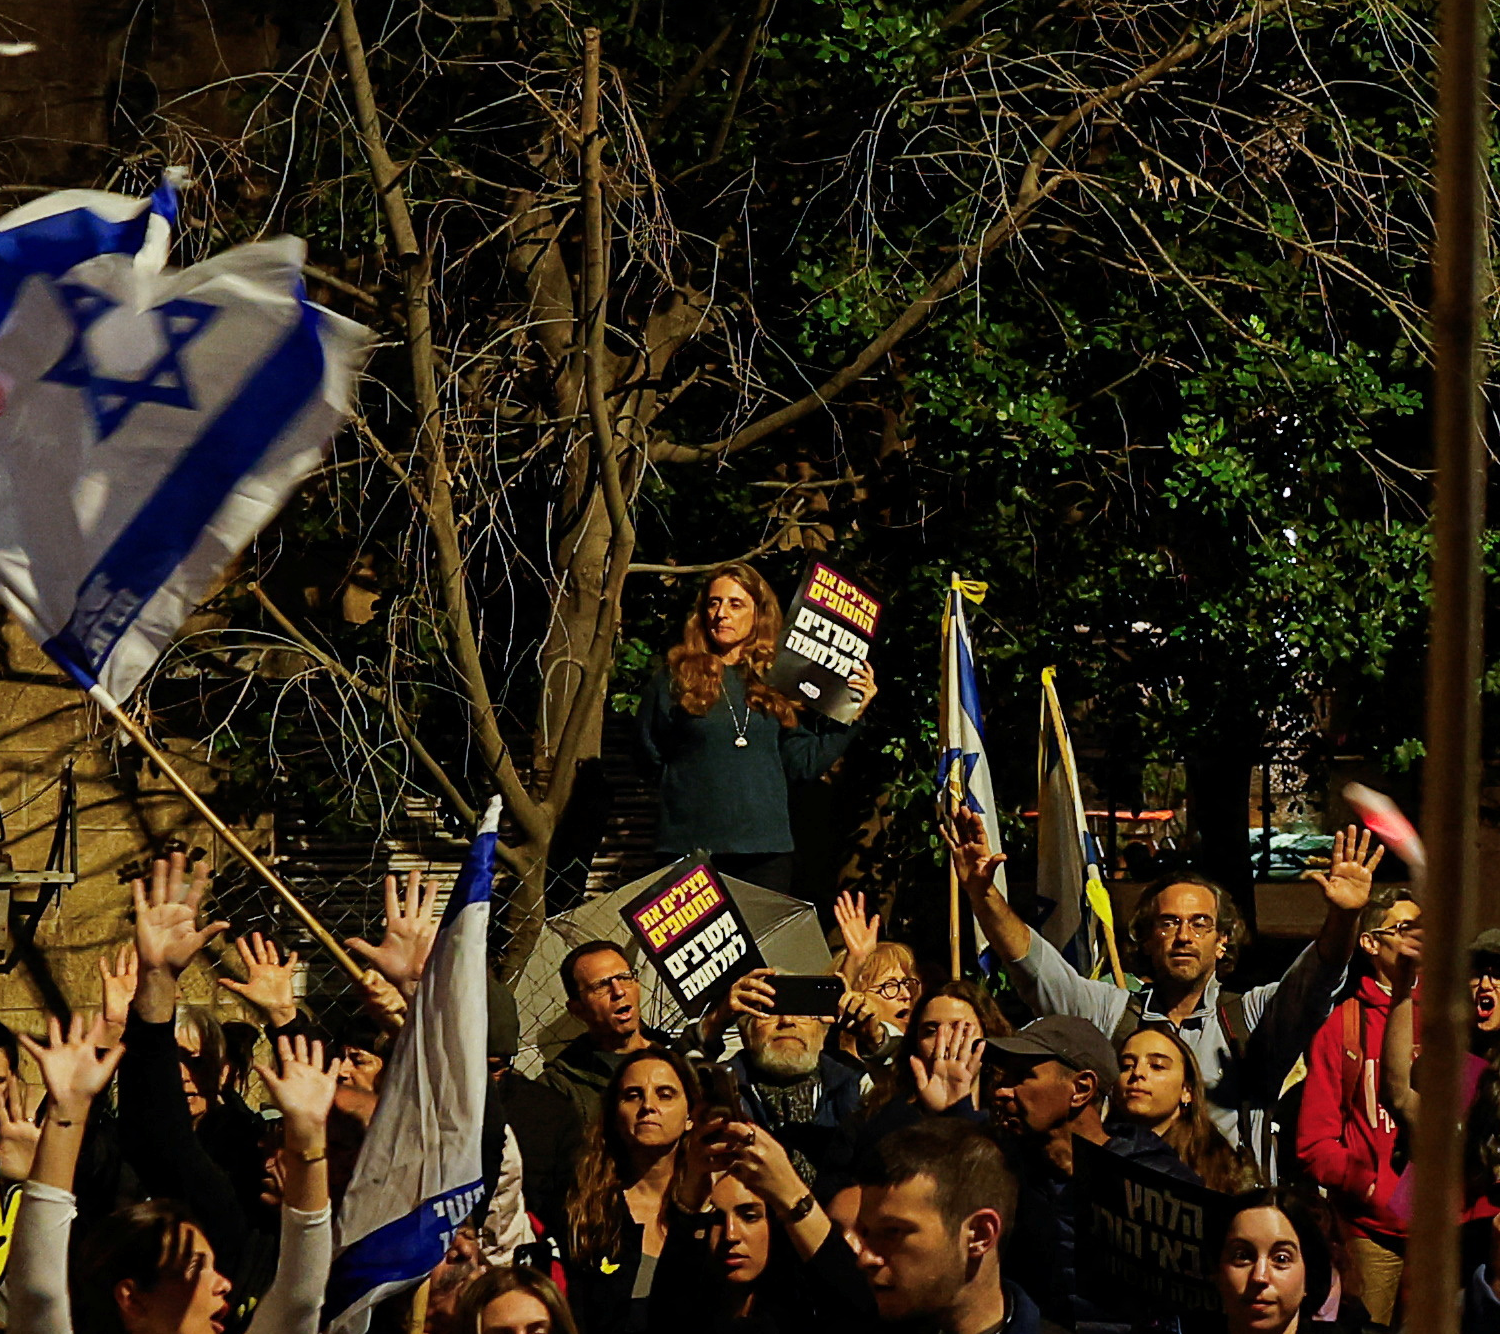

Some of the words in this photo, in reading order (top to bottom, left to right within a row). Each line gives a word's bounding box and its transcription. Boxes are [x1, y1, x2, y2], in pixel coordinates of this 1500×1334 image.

[815, 566, 838, 590] את
[836, 581, 878, 618] מצילים
[794, 606, 870, 661] מסרבים
[808, 581, 875, 634] החטופים
[637, 904, 664, 931] את
[647, 884, 721, 949] החטופים
[659, 869, 710, 915] מצילים
[664, 910, 739, 980] מסרבים
[678, 933, 747, 1002] למלחמה
[1123, 1177, 1204, 1240] הלחץ
[1150, 1229, 1205, 1280] באי
[1170, 1278, 1220, 1313] סקה
